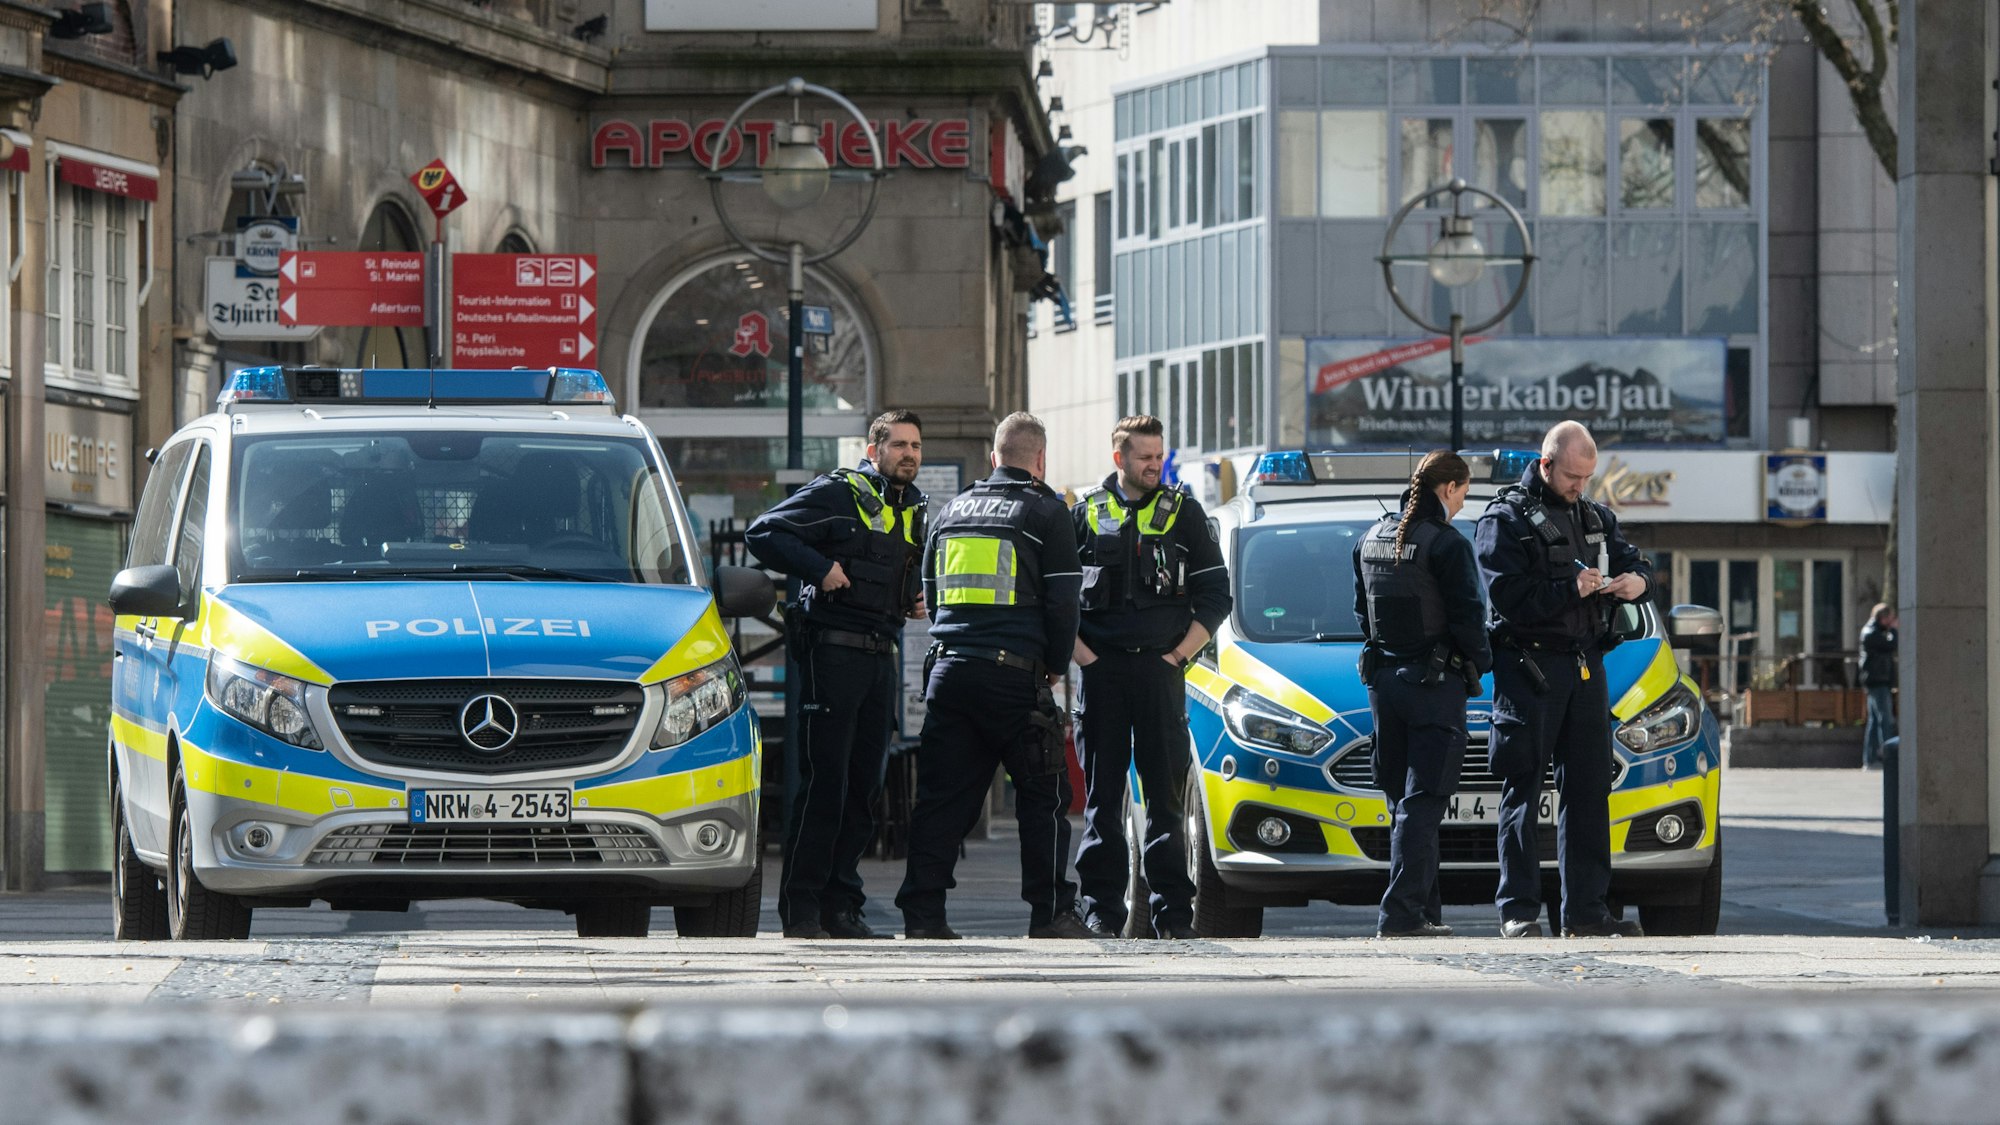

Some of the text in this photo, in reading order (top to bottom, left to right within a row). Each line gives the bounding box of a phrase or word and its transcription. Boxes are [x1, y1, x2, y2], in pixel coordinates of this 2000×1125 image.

[365, 259, 420, 269] St. Reinoldi
[370, 271, 420, 282] St. Marien
[457, 295, 551, 306] Tourist-Information
[370, 303, 421, 313] Adlerturm
[457, 313, 577, 323] Deutsches Fußballmuseum
[456, 333, 496, 344] St. Petri
[456, 346, 525, 358] Propsteikirche
[1360, 374, 1672, 420] Winterkabeljau
[48, 432, 118, 479] WEMPE
[949, 499, 1018, 518] POLIZEI
[1364, 541, 1417, 560] ORDNUNGAMT
[365, 617, 591, 639] POLIZEI
[415, 809, 422, 818] D
